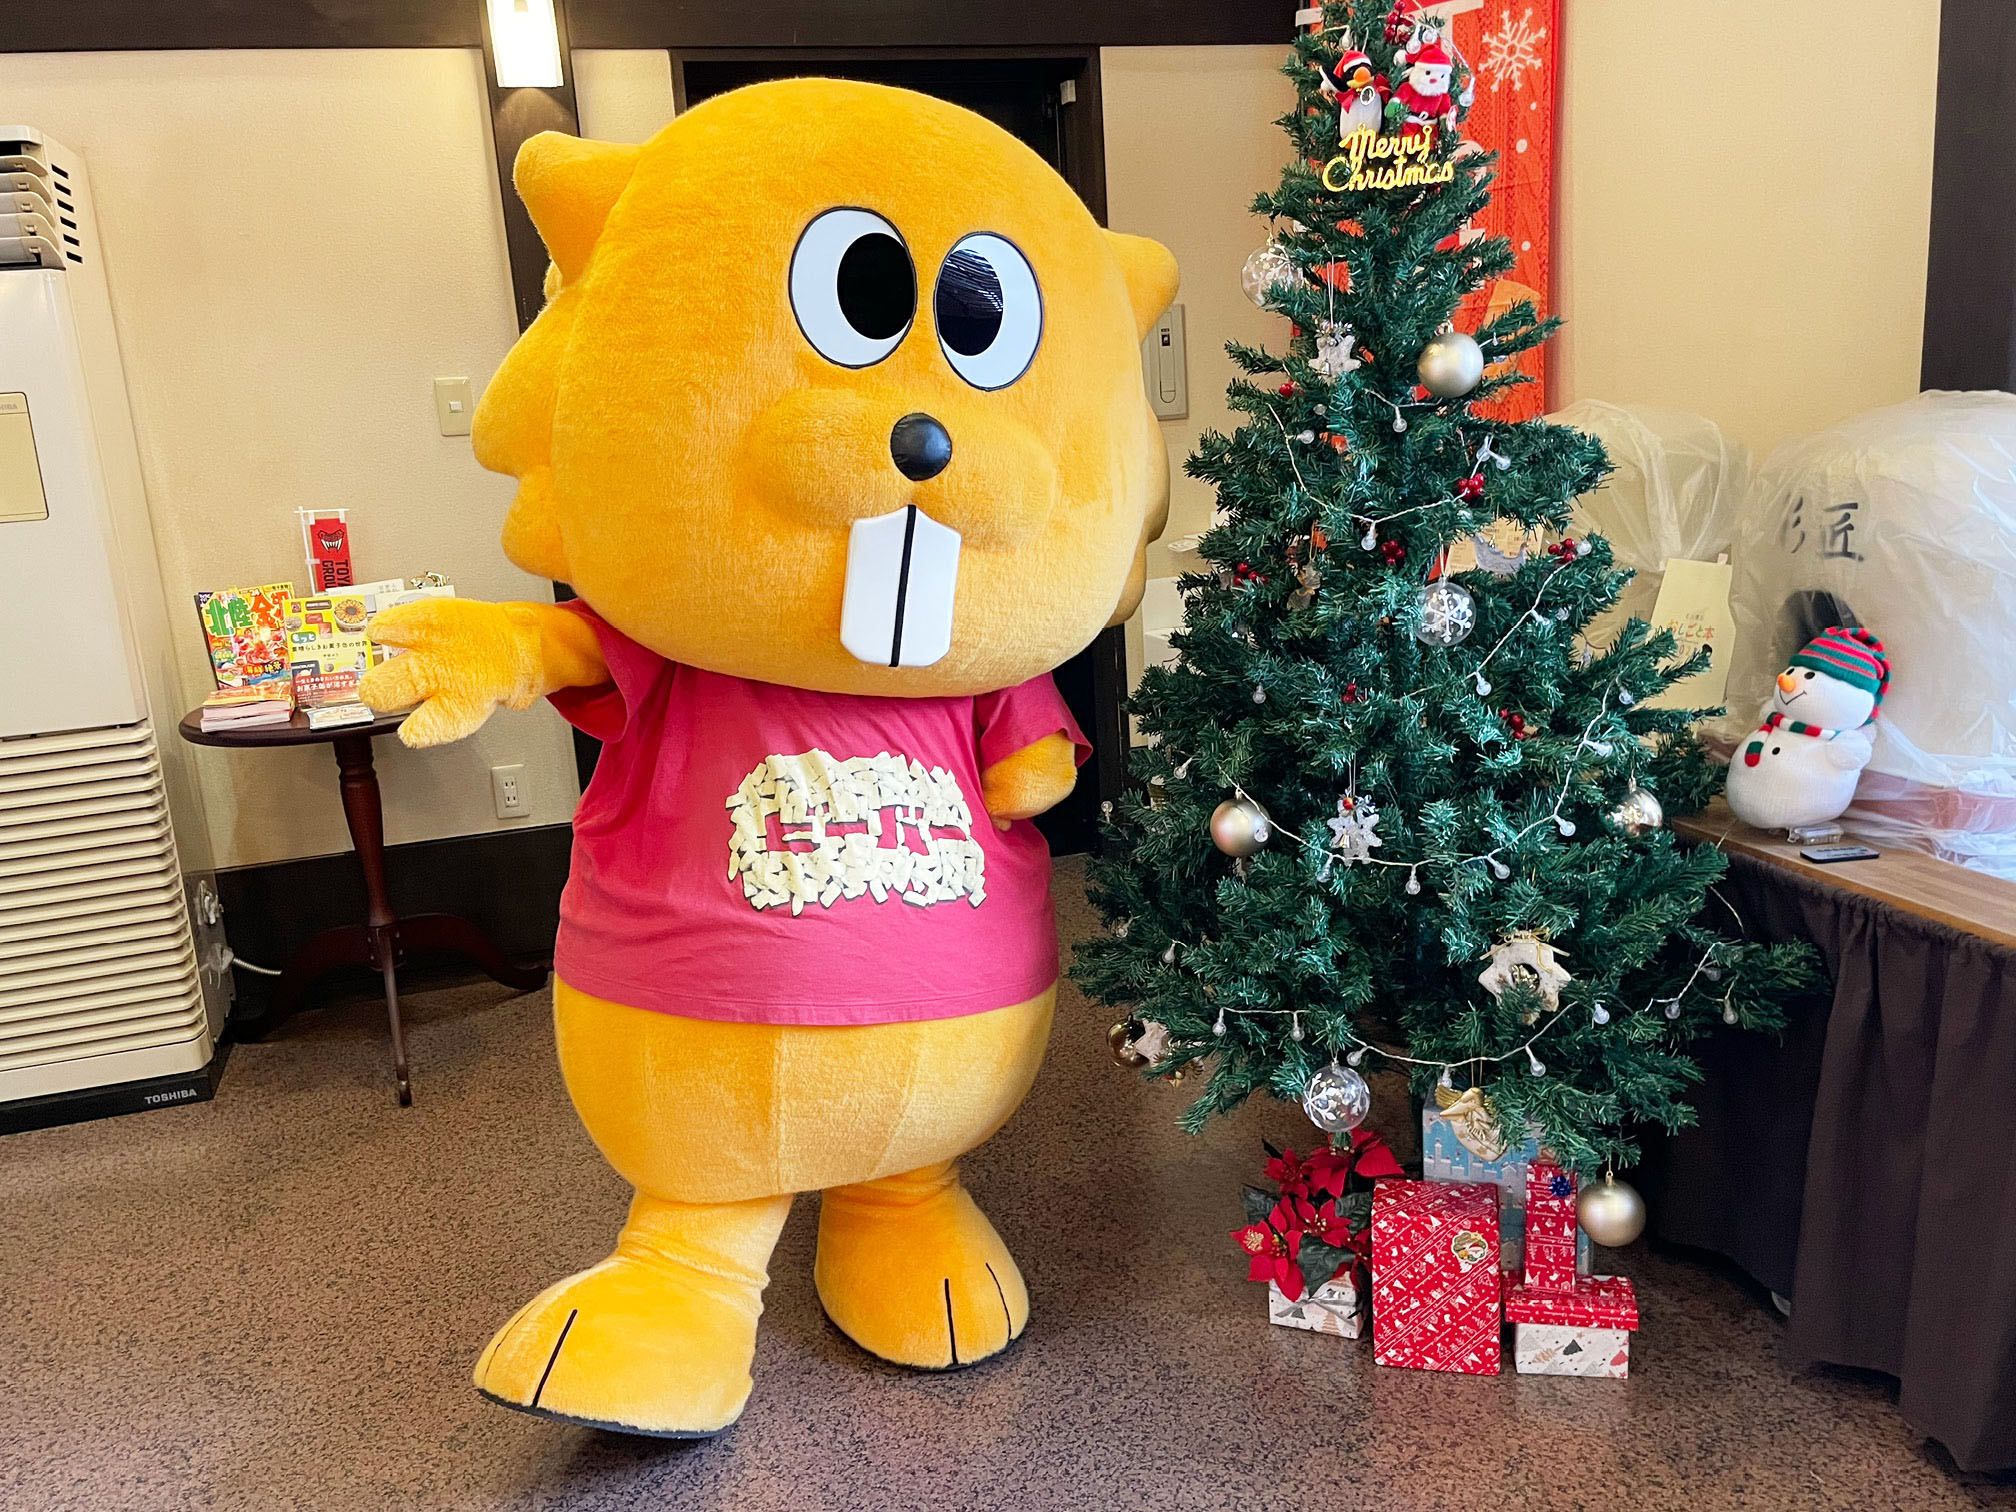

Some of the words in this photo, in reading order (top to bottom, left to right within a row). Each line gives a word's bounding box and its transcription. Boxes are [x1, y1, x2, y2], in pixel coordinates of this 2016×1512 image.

[1339, 123, 1432, 163] Merry
[1322, 156, 1454, 192] Christmas
[144, 1088, 198, 1105] TOSHIBA
